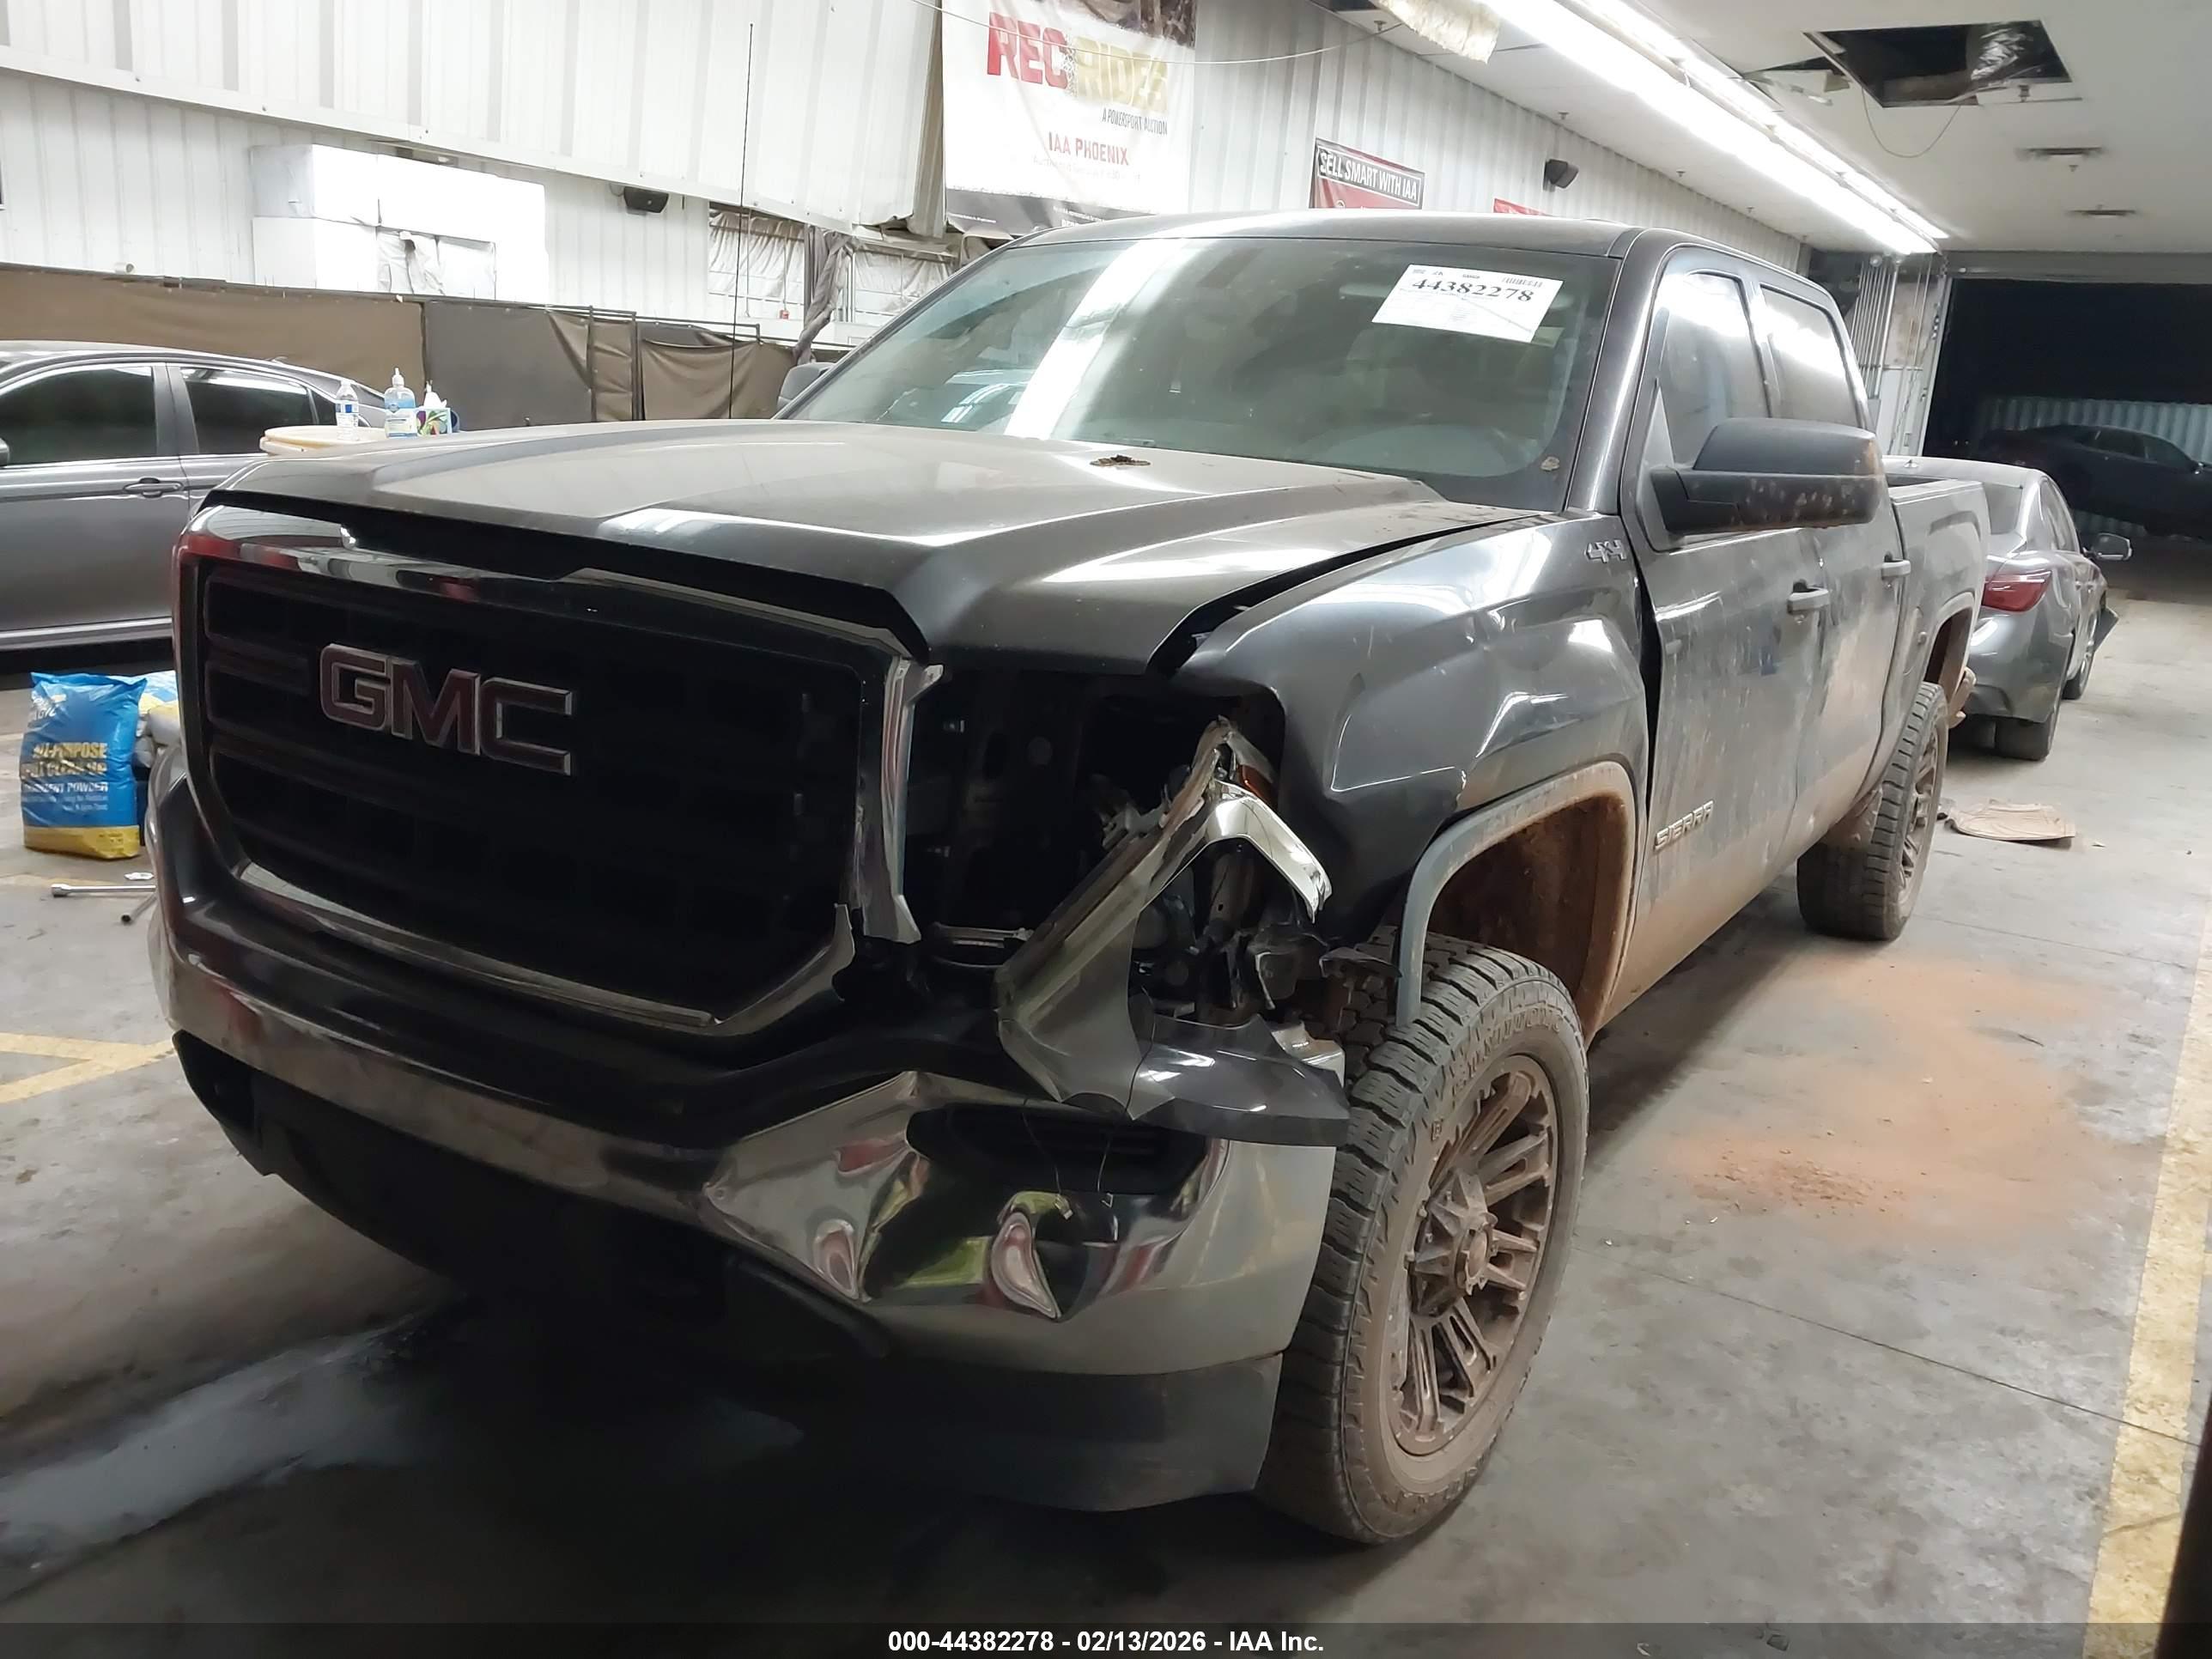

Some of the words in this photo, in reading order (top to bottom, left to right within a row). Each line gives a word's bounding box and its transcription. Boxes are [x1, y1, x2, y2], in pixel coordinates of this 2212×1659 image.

[1144, 117, 1169, 136] AUCTION
[1048, 131, 1072, 156] IAA
[1075, 137, 1130, 167] PHOENIX
[1319, 151, 1343, 179] SELL
[1344, 160, 1377, 189] SMART
[1378, 169, 1401, 195] WITH
[1401, 178, 1418, 200] IAA
[1412, 277, 1535, 302] 44382278
[319, 642, 573, 776] GMC
[67, 781, 109, 793] POWDER
[1654, 799, 1715, 850] SIERRA
